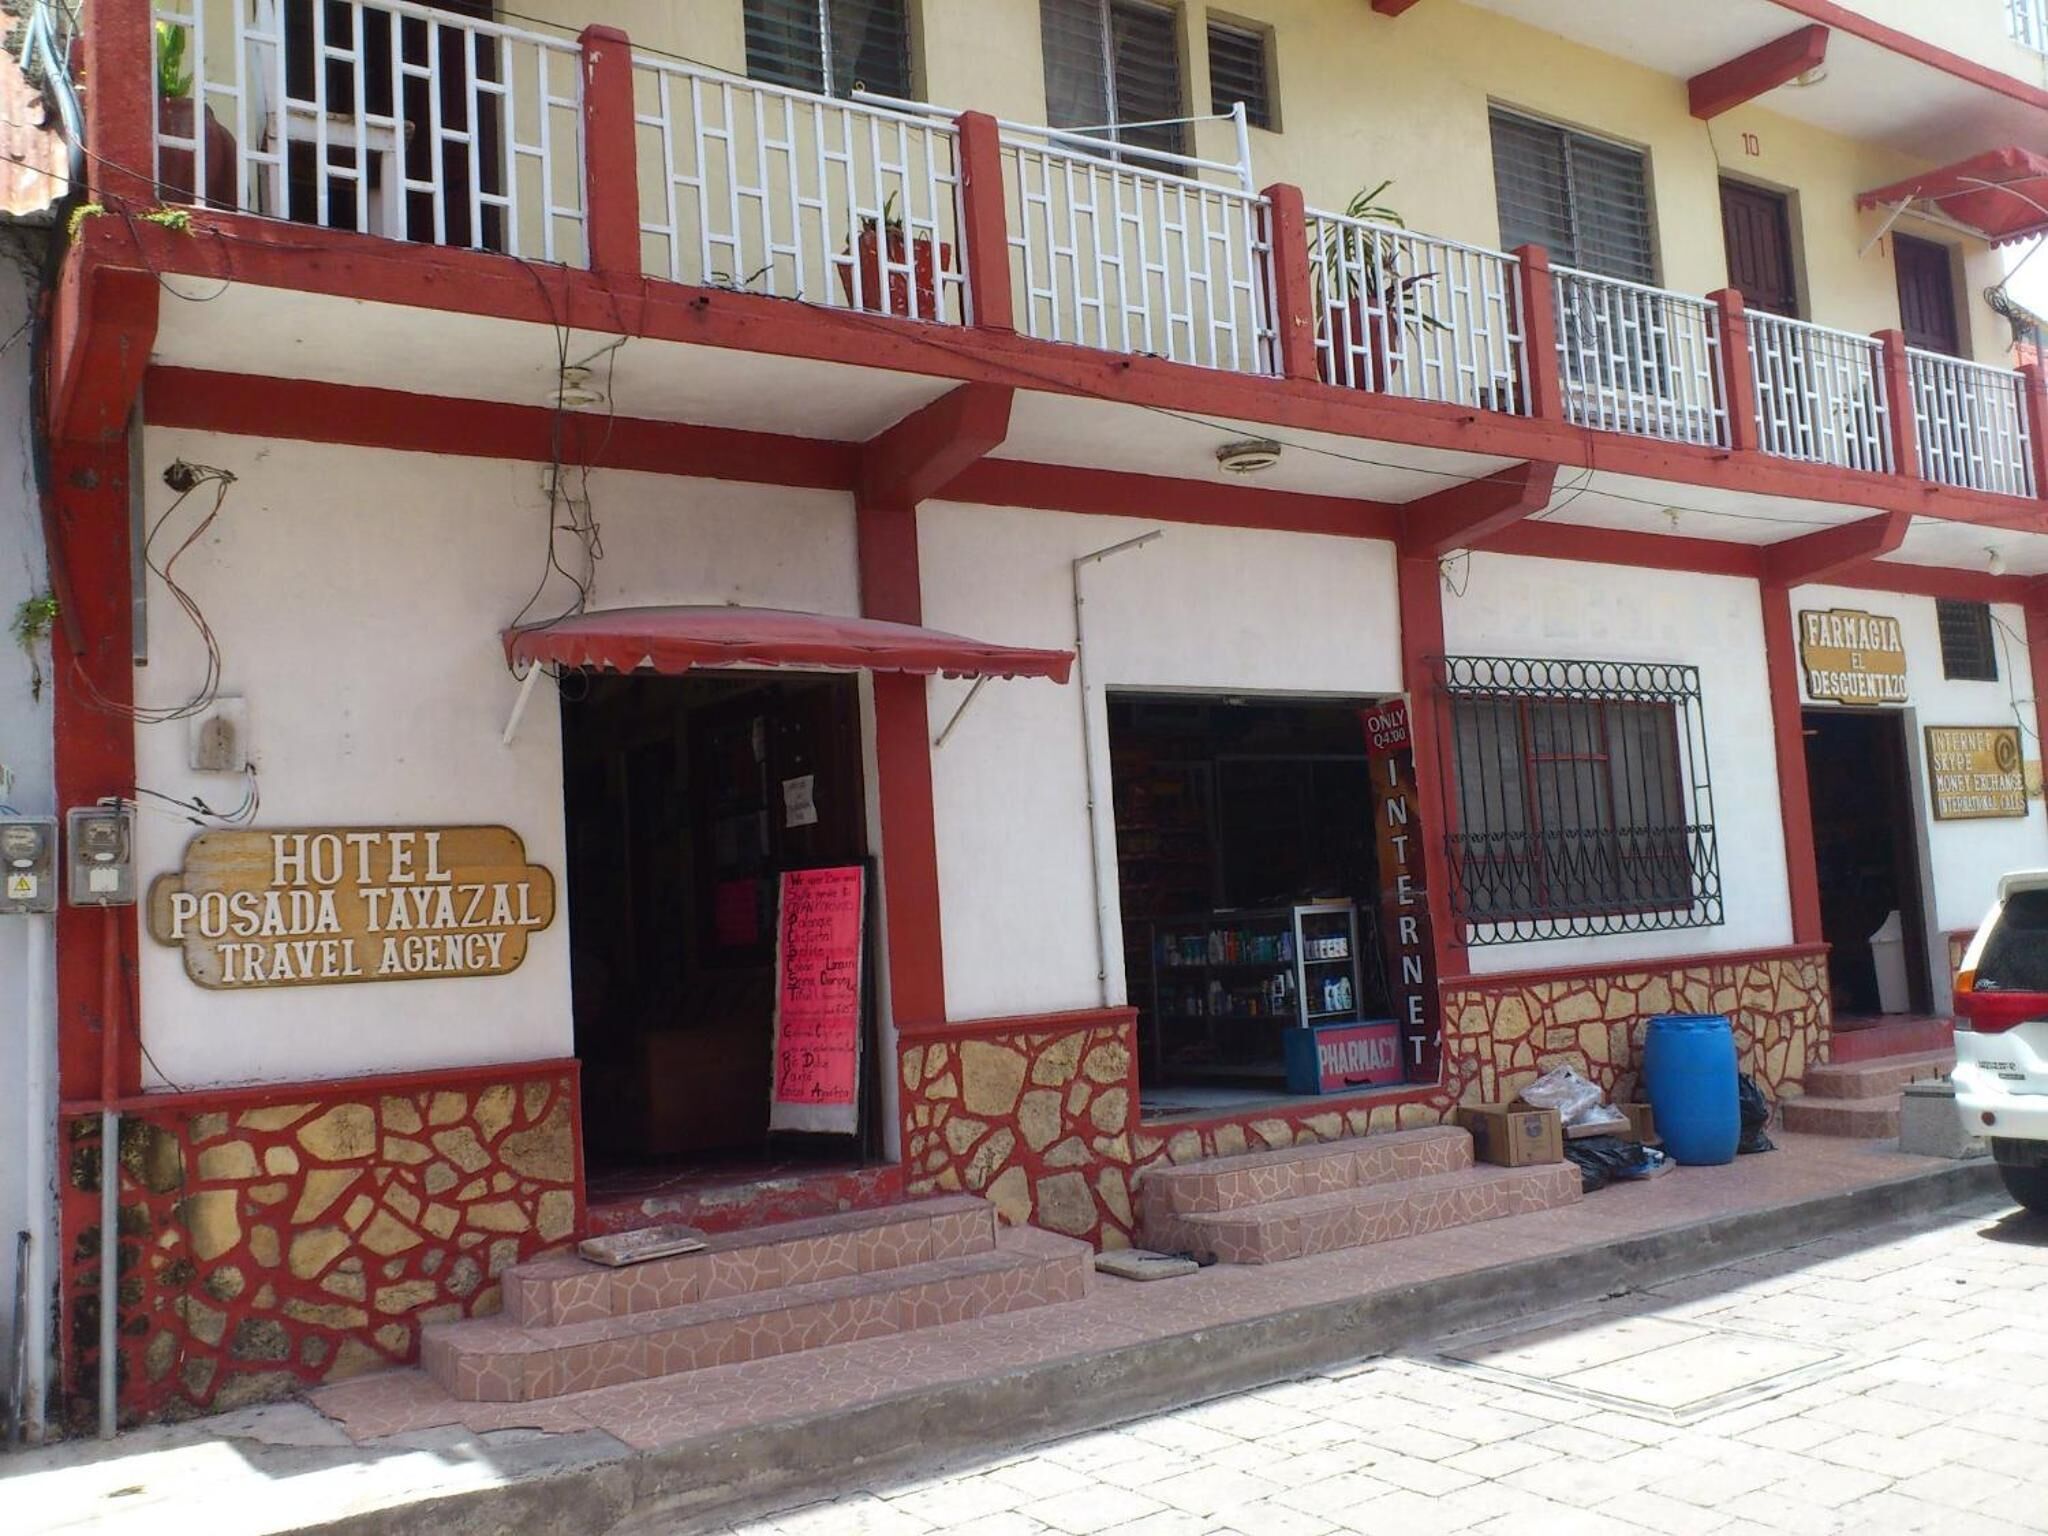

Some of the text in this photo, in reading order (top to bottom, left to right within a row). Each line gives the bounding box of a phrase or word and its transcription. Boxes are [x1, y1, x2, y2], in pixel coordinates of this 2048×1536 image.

[1741, 132, 1760, 157] 10
[1807, 614, 1902, 652] FARMACIA
[1851, 652, 1866, 669] EL
[1810, 670, 1907, 698] DESCUENTAZO
[1367, 709, 1404, 732] ONLY
[1930, 728, 1992, 752] INTERNET
[1934, 752, 1973, 771] SKYPE
[1936, 772, 2024, 792] MONEY EXCHANGE
[271, 832, 451, 886] HOTEL
[170, 882, 541, 939] POSADA TAYAZAL
[1386, 758, 1427, 1066] INTERNET
[218, 932, 506, 982] TRAVEL AGENCY
[1317, 1036, 1398, 1076] PHARMACY
